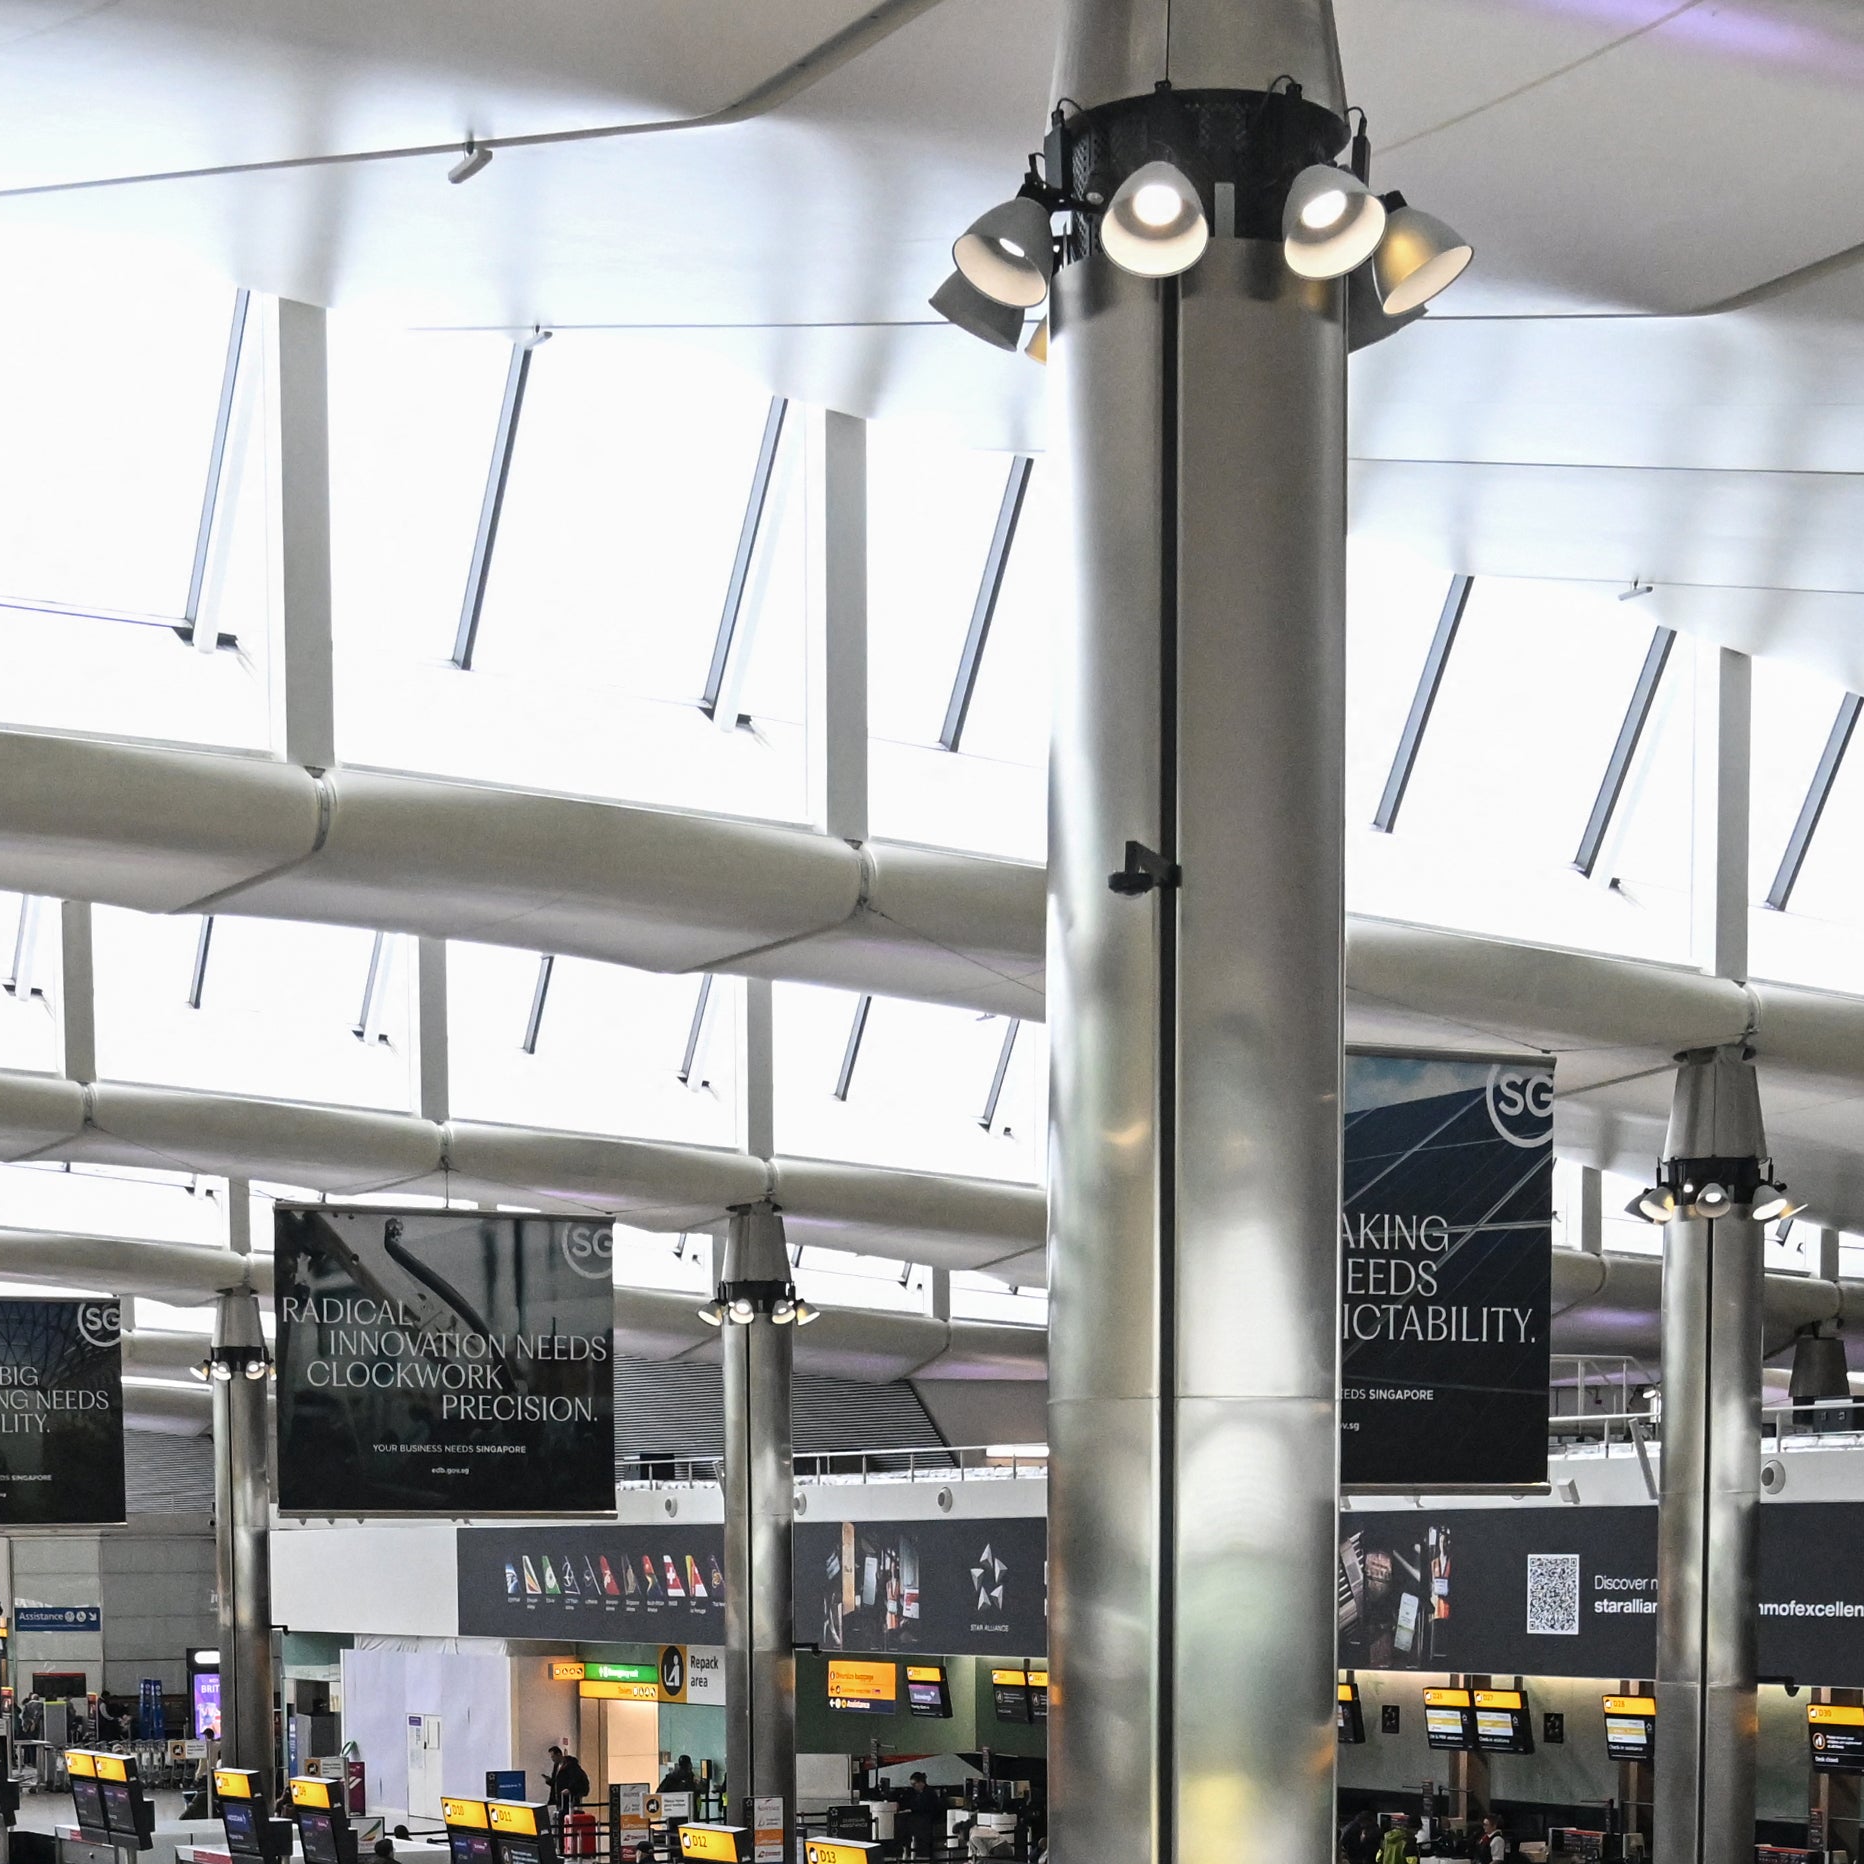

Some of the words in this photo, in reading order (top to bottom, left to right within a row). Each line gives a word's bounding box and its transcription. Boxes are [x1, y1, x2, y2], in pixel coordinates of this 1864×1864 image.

[1498, 1074, 1553, 1118] SG
[571, 1228, 612, 1258] SG
[283, 1297, 414, 1326] RADICAL
[86, 1308, 120, 1331] SG
[330, 1330, 506, 1358] INNOVATION
[517, 1334, 607, 1361] NEEDS
[0, 1367, 39, 1385] BIG
[307, 1361, 504, 1390] CLOCKWORK
[36, 1391, 109, 1409] NEEDS
[1369, 1389, 1433, 1400] SINGAPORE
[442, 1395, 598, 1422] PRECISION.
[373, 1444, 398, 1452] YOUR
[400, 1444, 442, 1453] BUSINESS
[445, 1445, 474, 1453] NEEDS
[476, 1445, 526, 1453] SINGAPORE
[431, 1467, 469, 1475] edb.gov.sg
[1595, 1575, 1649, 1590] Discover
[19, 1611, 63, 1621] Assistance
[690, 1656, 718, 1671] Repack
[690, 1676, 708, 1687] area
[452, 1805, 464, 1816] D10
[499, 1810, 512, 1822] D11
[693, 1835, 707, 1847] D12
[820, 1850, 836, 1863] D13
